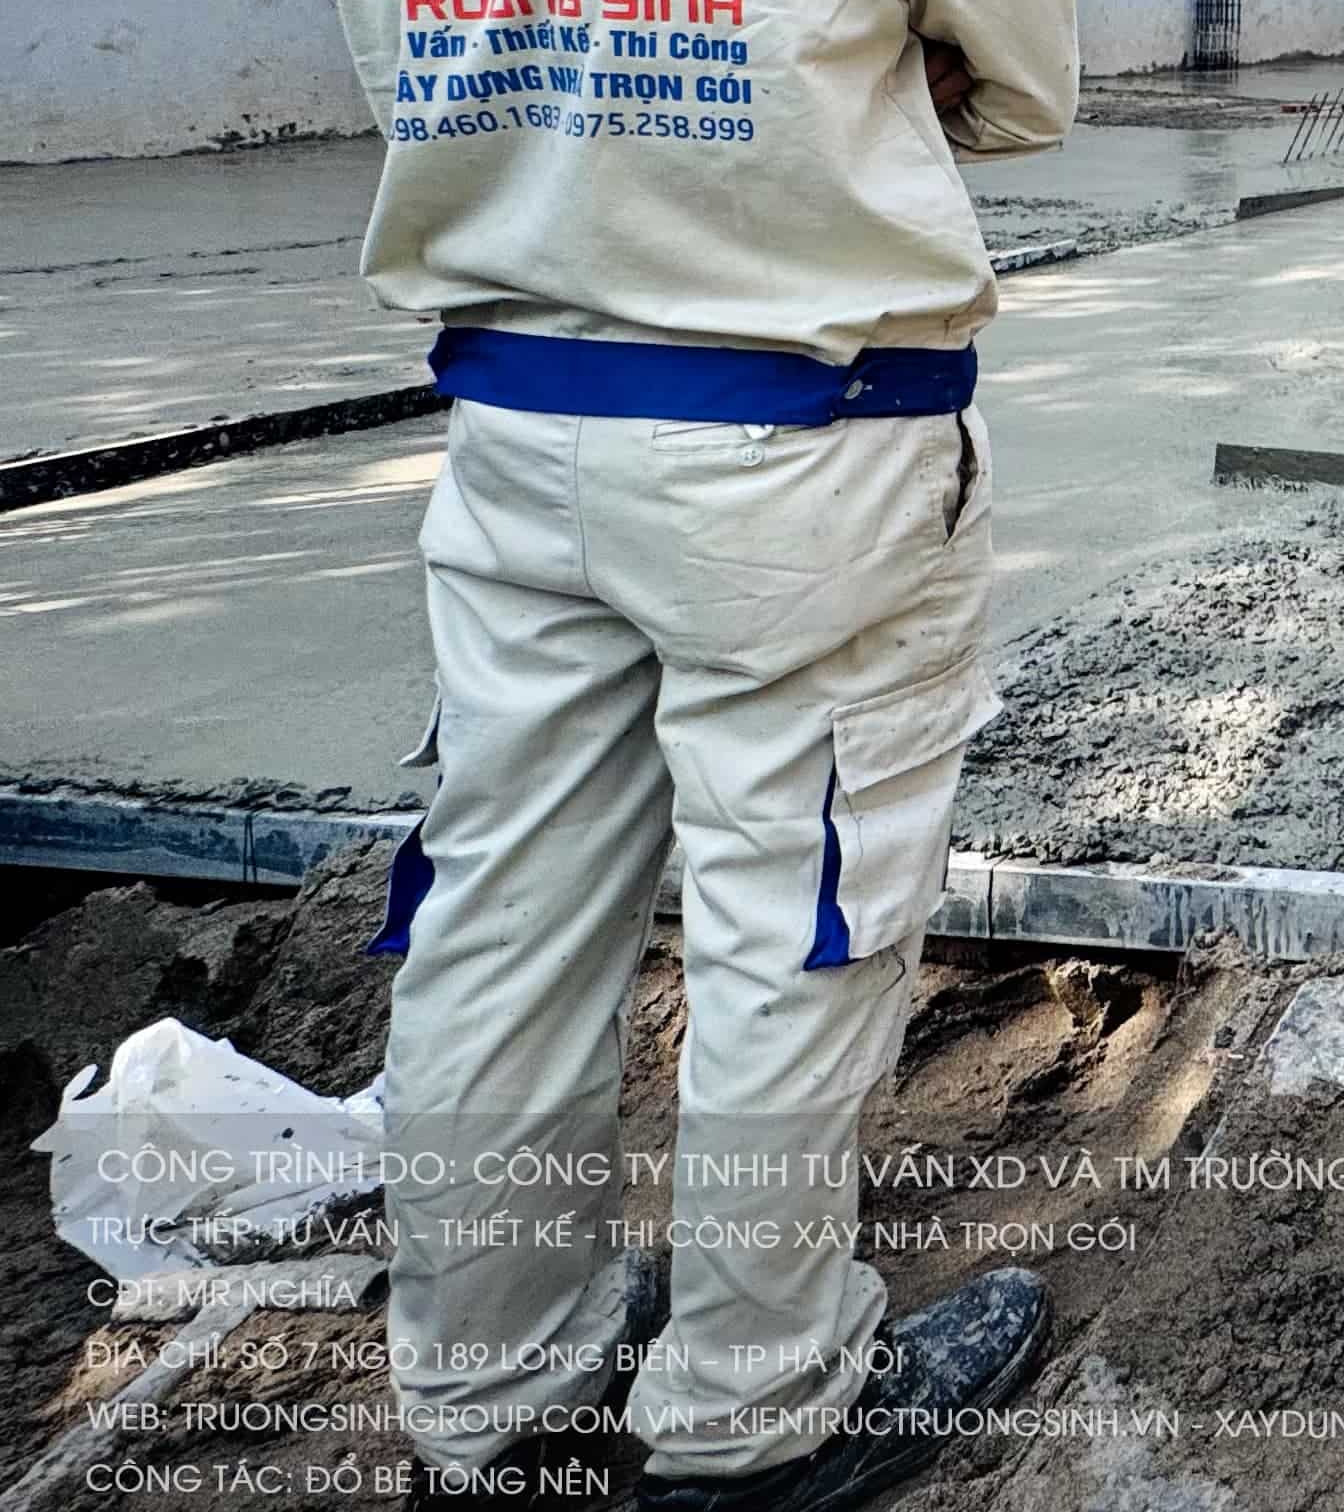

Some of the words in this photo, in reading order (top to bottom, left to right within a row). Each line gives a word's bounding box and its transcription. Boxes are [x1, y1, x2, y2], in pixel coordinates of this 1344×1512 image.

[408, 25, 465, 59] Vấn
[560, 24, 591, 60] Kế
[609, 30, 656, 59] Thi
[668, 30, 748, 66] Công
[397, 70, 438, 103] ÂY
[448, 64, 542, 103] DỰNG
[590, 73, 682, 104] TRỌN
[696, 74, 752, 104] GÓI
